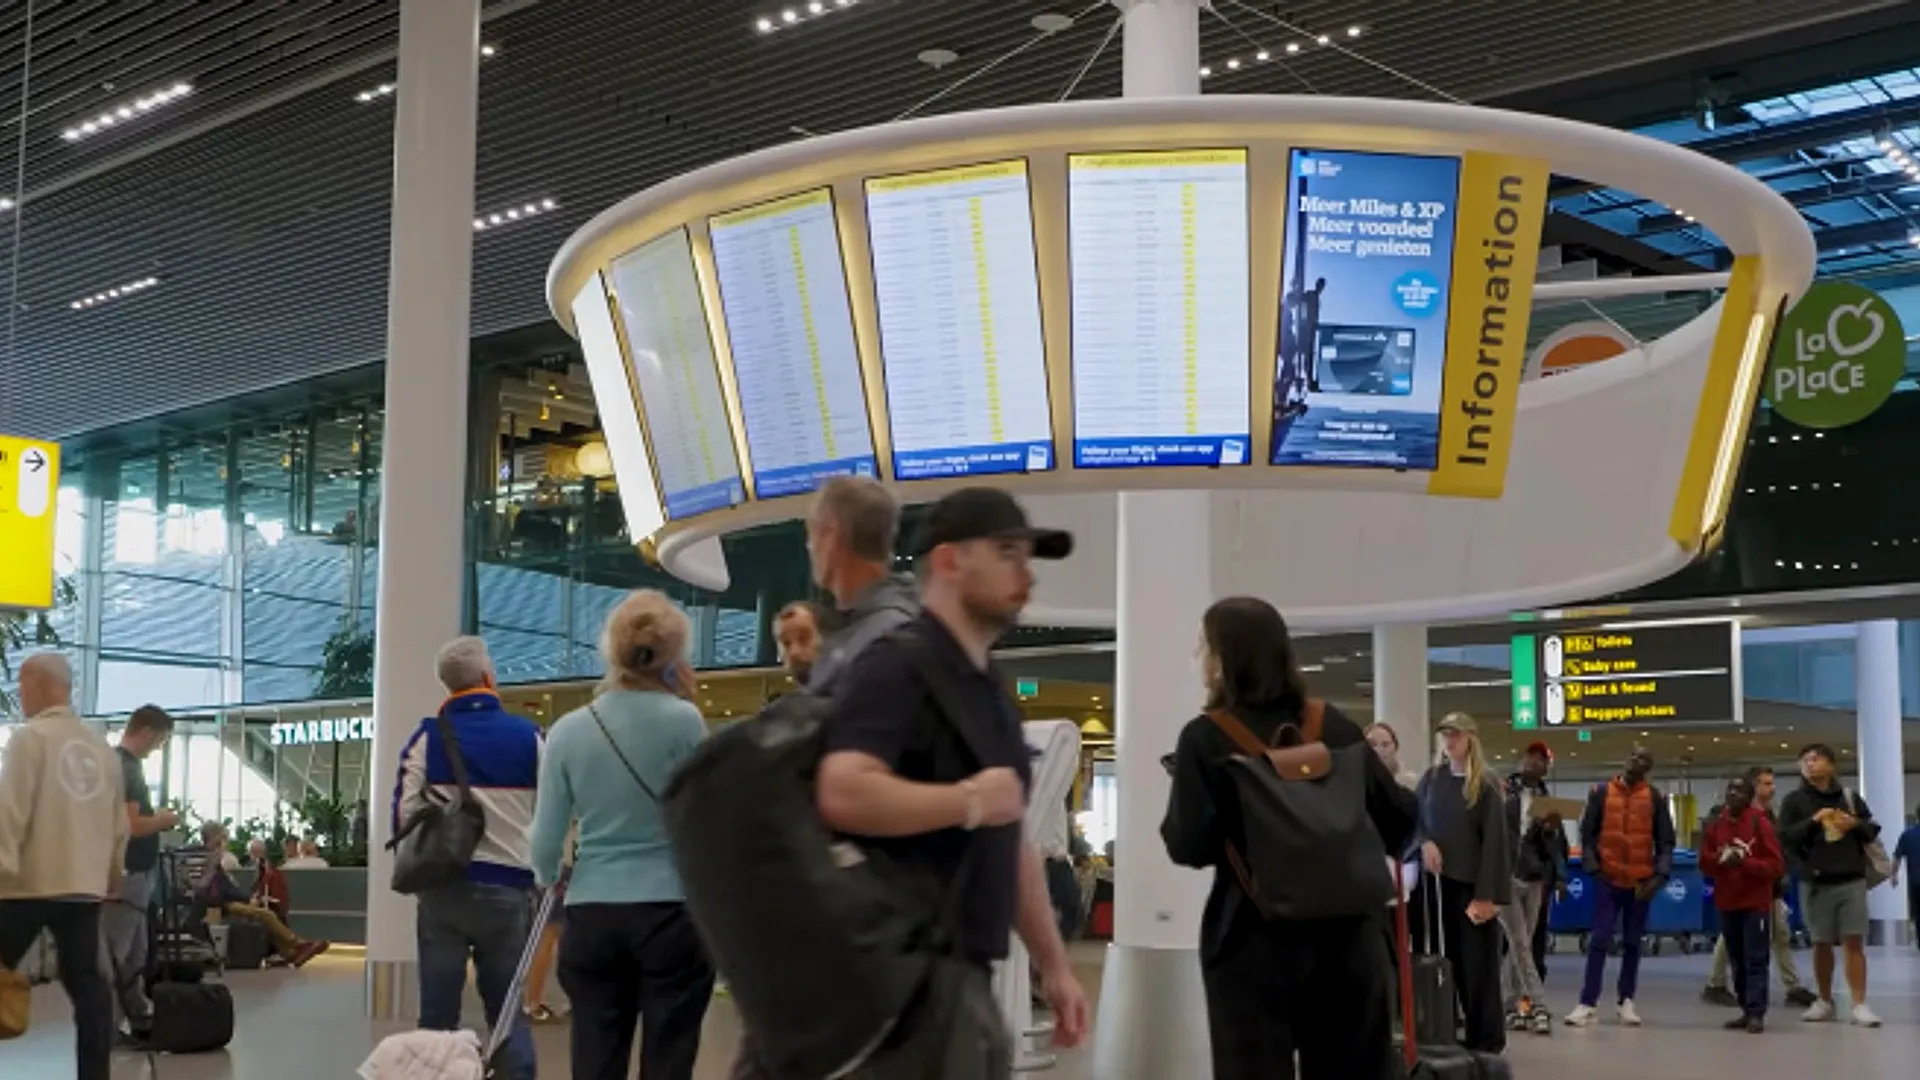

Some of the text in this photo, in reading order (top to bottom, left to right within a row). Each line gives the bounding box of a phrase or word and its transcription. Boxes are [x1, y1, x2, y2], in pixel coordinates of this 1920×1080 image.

[1300, 196, 1446, 220] Meer Miles & XP
[1308, 216, 1434, 239] Meer voordeel
[1308, 235, 1431, 258] Meer genieten
[1457, 174, 1523, 466] Information
[1584, 683, 1607, 695] Lost
[1610, 683, 1618, 694] &
